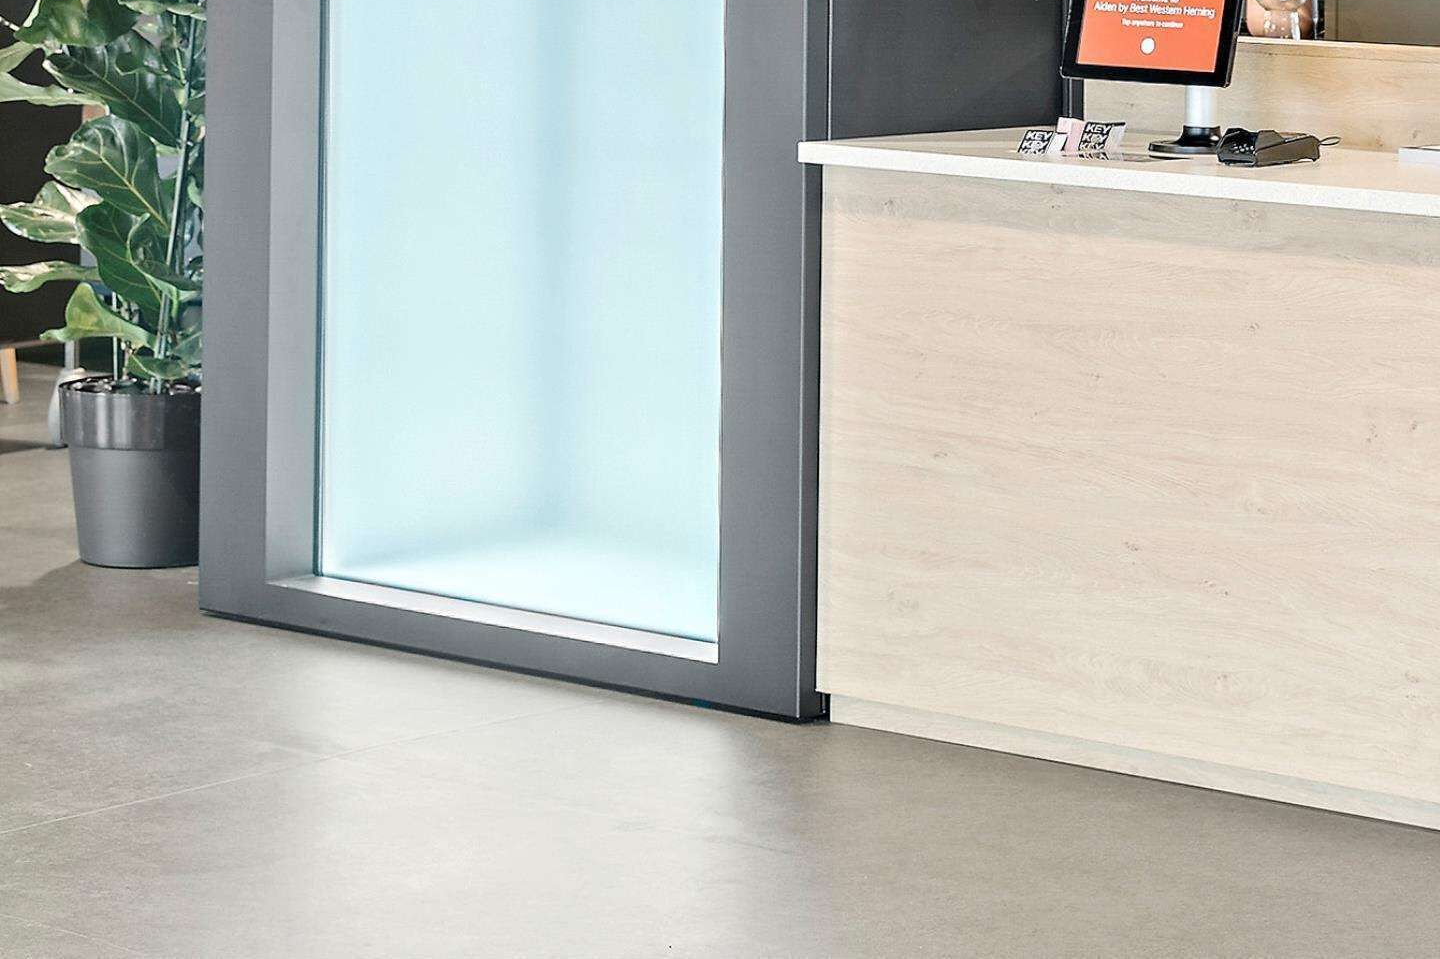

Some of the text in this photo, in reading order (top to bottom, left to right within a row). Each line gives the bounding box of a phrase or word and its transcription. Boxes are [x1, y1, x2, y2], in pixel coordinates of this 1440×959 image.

[1094, 1, 1117, 12] Aiden
[1119, 2, 1129, 14] by
[1129, 3, 1148, 13] Best
[1149, 4, 1182, 15] Western
[1085, 123, 1111, 134] KEY
[1025, 131, 1053, 141] KEY
[1081, 132, 1107, 144] KY
[1022, 140, 1049, 149] KY
